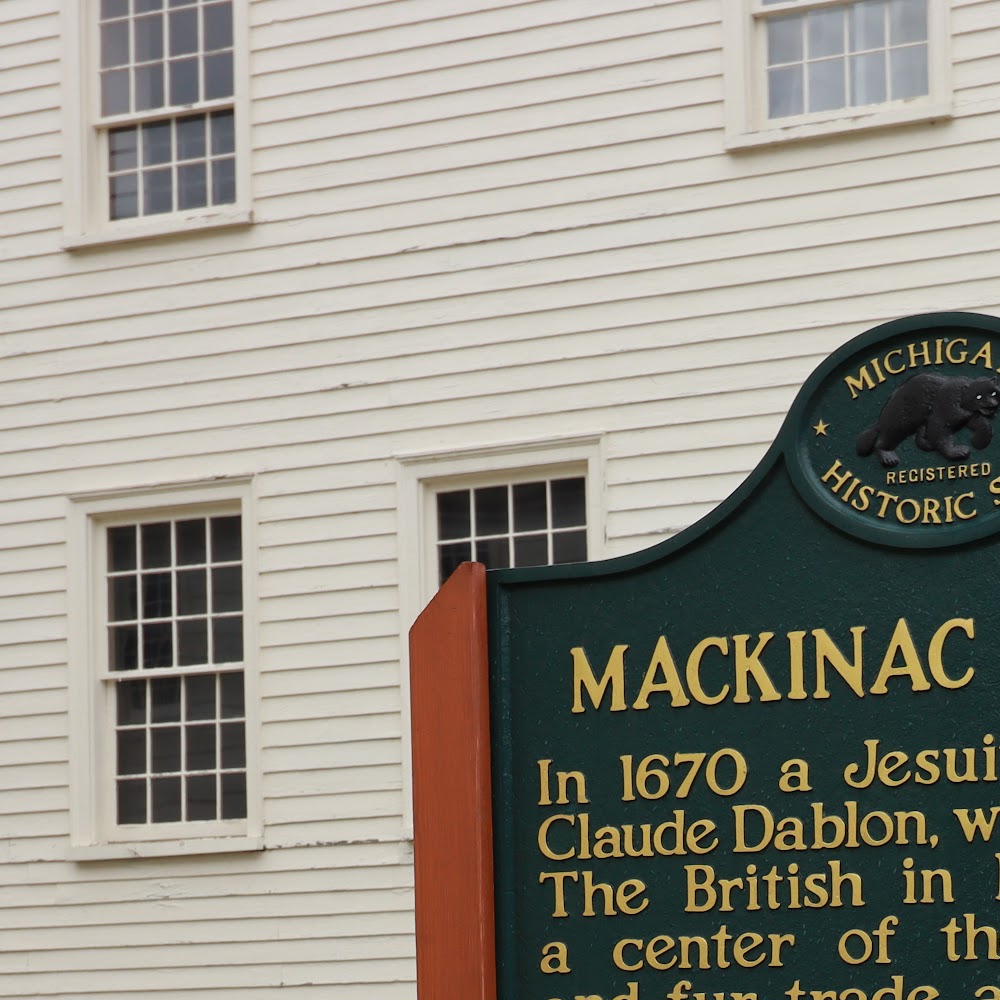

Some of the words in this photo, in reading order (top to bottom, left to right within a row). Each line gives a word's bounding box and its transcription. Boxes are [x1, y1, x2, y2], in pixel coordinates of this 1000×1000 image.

[821, 460, 977, 524] HISTORIC
[887, 462, 991, 485] REGISTERED
[570, 618, 974, 713] MACKINAC
[537, 759, 589, 805] In
[620, 748, 747, 801] 1670
[779, 759, 811, 792] a
[538, 810, 718, 860] Claude
[732, 801, 938, 852] Dablon,
[539, 871, 649, 917] The
[684, 860, 864, 912] British
[903, 858, 954, 903] in
[541, 942, 570, 973] a
[613, 926, 795, 970] center
[838, 916, 898, 964] of
